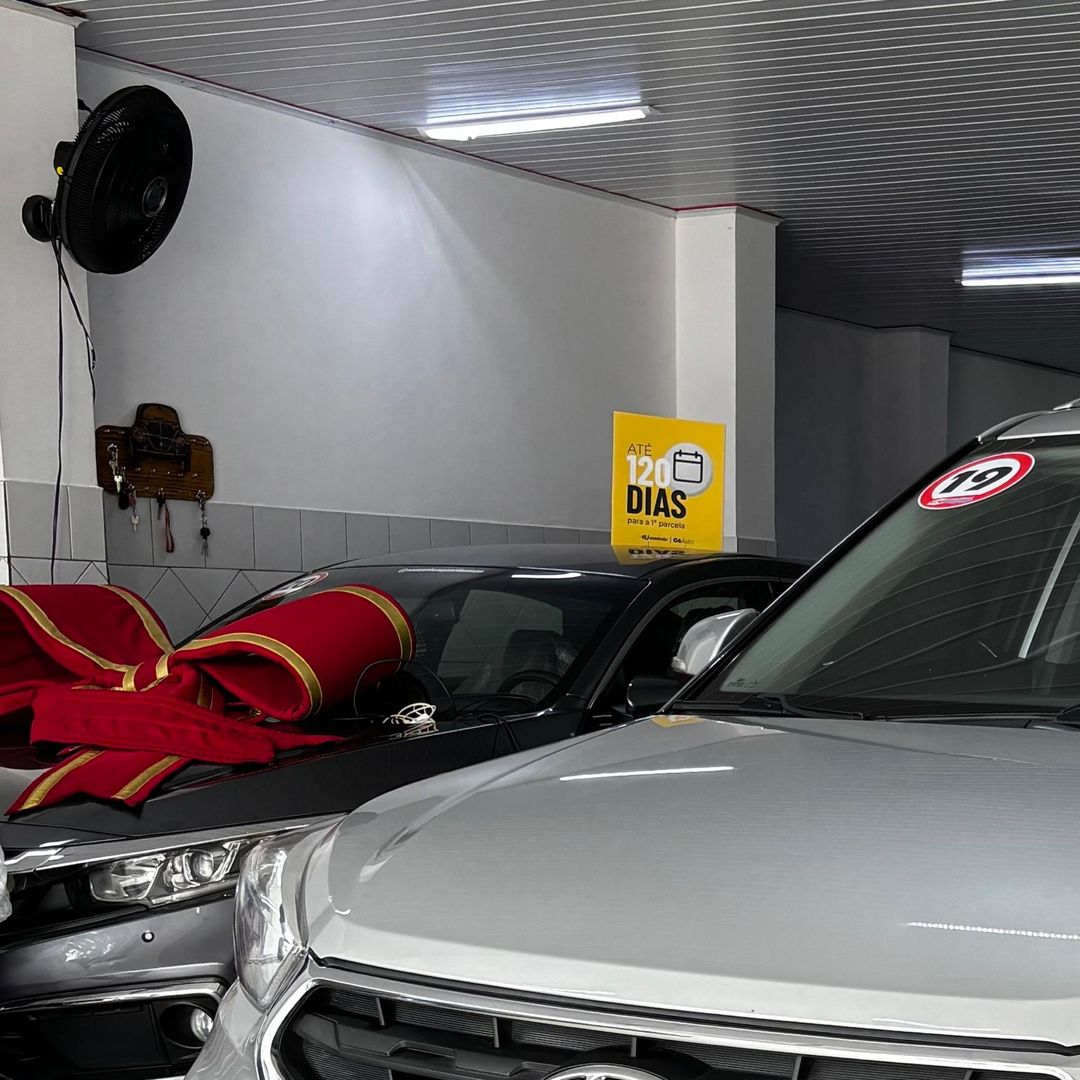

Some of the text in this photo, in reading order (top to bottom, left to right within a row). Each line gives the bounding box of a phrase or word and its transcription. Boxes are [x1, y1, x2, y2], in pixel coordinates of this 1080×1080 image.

[627, 443, 652, 456] ATÉ
[626, 455, 671, 487] 120
[939, 466, 1014, 495] 19
[626, 485, 687, 519] DIAS
[627, 518, 644, 526] para
[658, 521, 685, 529] parcela
